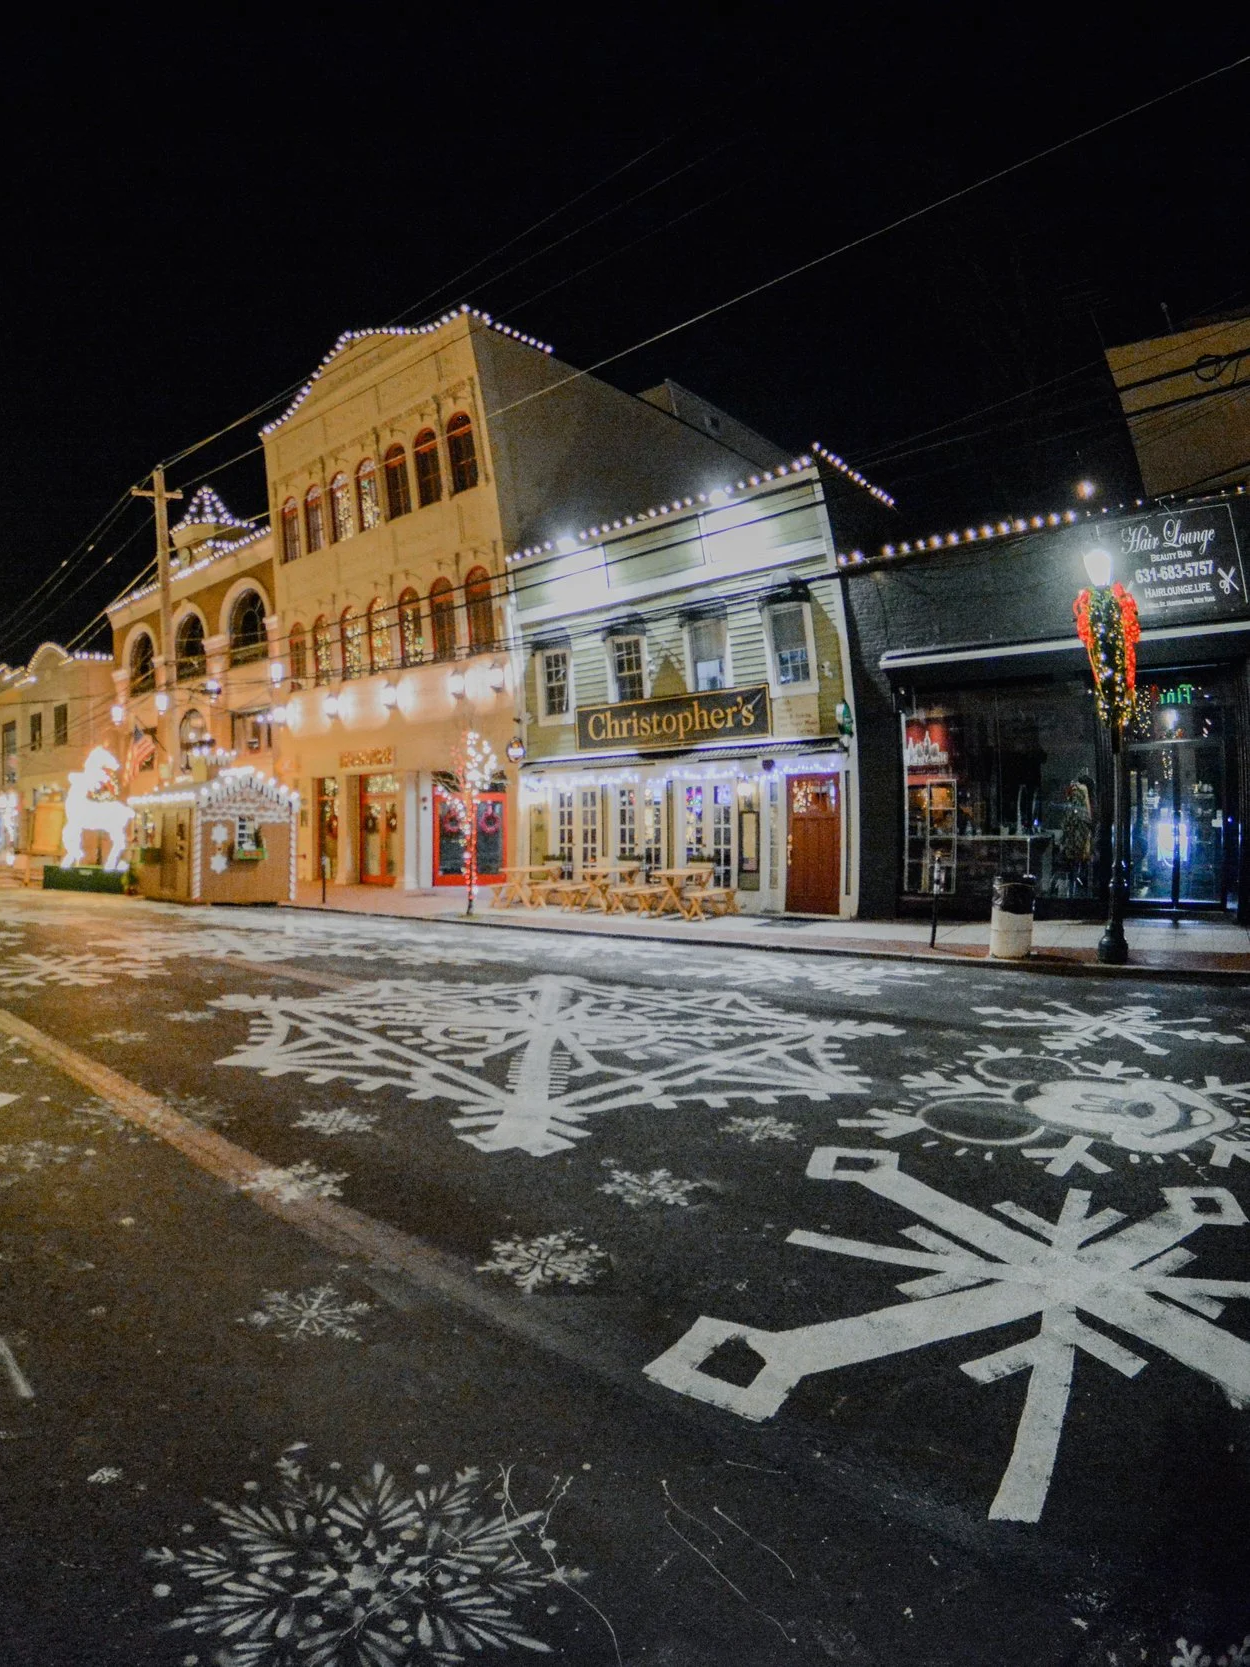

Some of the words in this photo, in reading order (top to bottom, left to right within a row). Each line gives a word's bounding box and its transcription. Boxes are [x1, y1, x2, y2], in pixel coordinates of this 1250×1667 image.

[1121, 525, 1159, 554] Hair
[1163, 519, 1215, 555] Lounge
[1135, 560, 1213, 583] 631-683-5757
[587, 696, 755, 741] Christopher's
